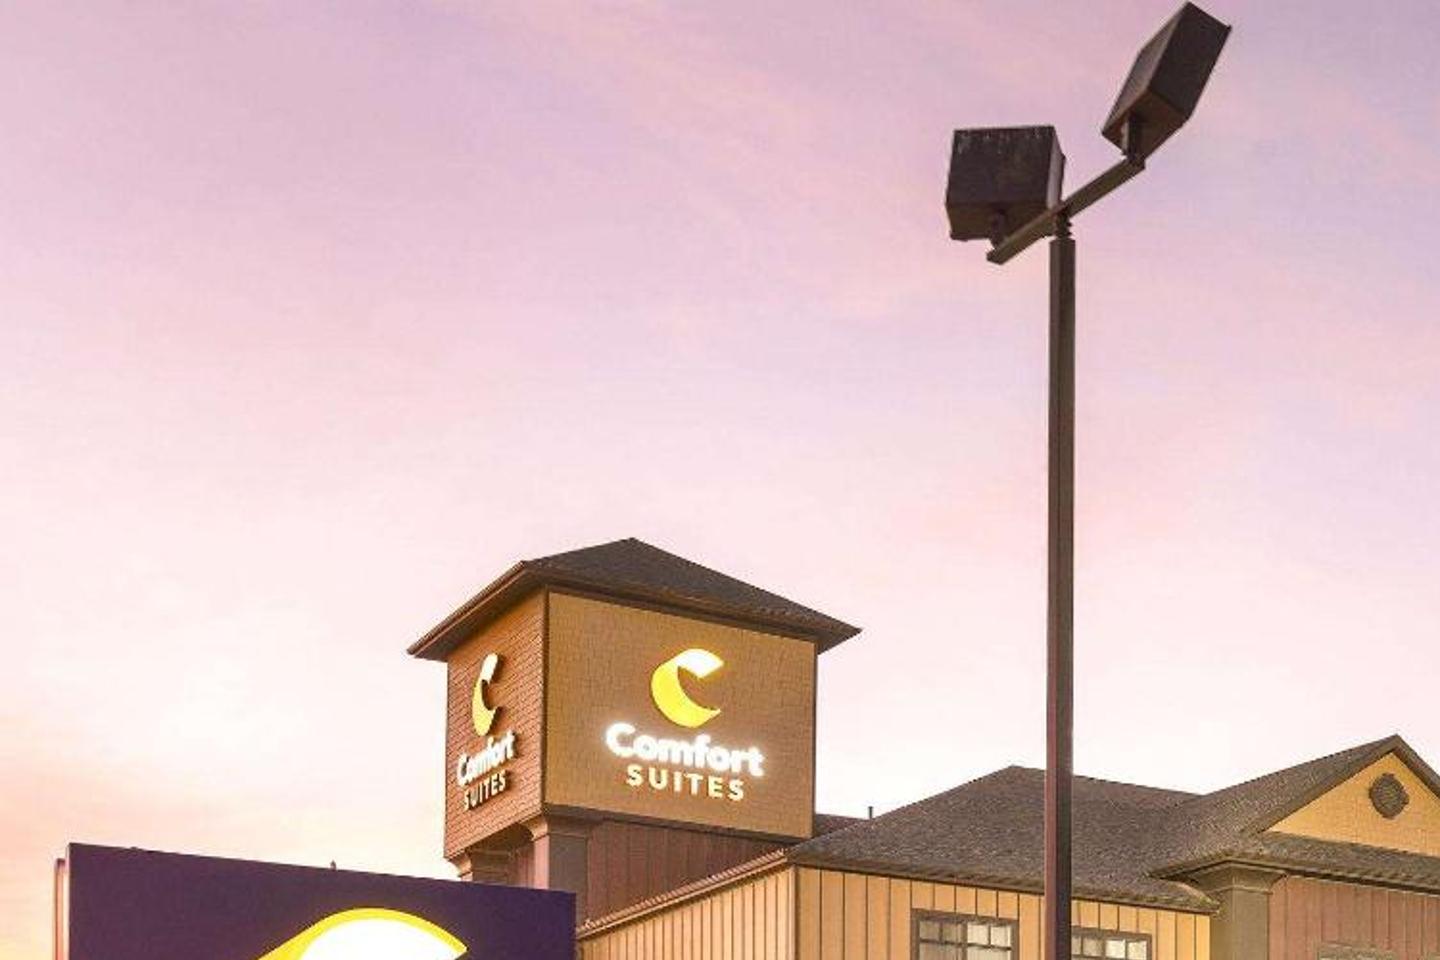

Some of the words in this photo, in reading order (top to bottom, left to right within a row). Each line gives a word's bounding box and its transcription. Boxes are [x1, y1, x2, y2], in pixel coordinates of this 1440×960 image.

[605, 721, 767, 778] Comfort
[463, 769, 507, 812] SUITES
[625, 764, 745, 801] SUITES
